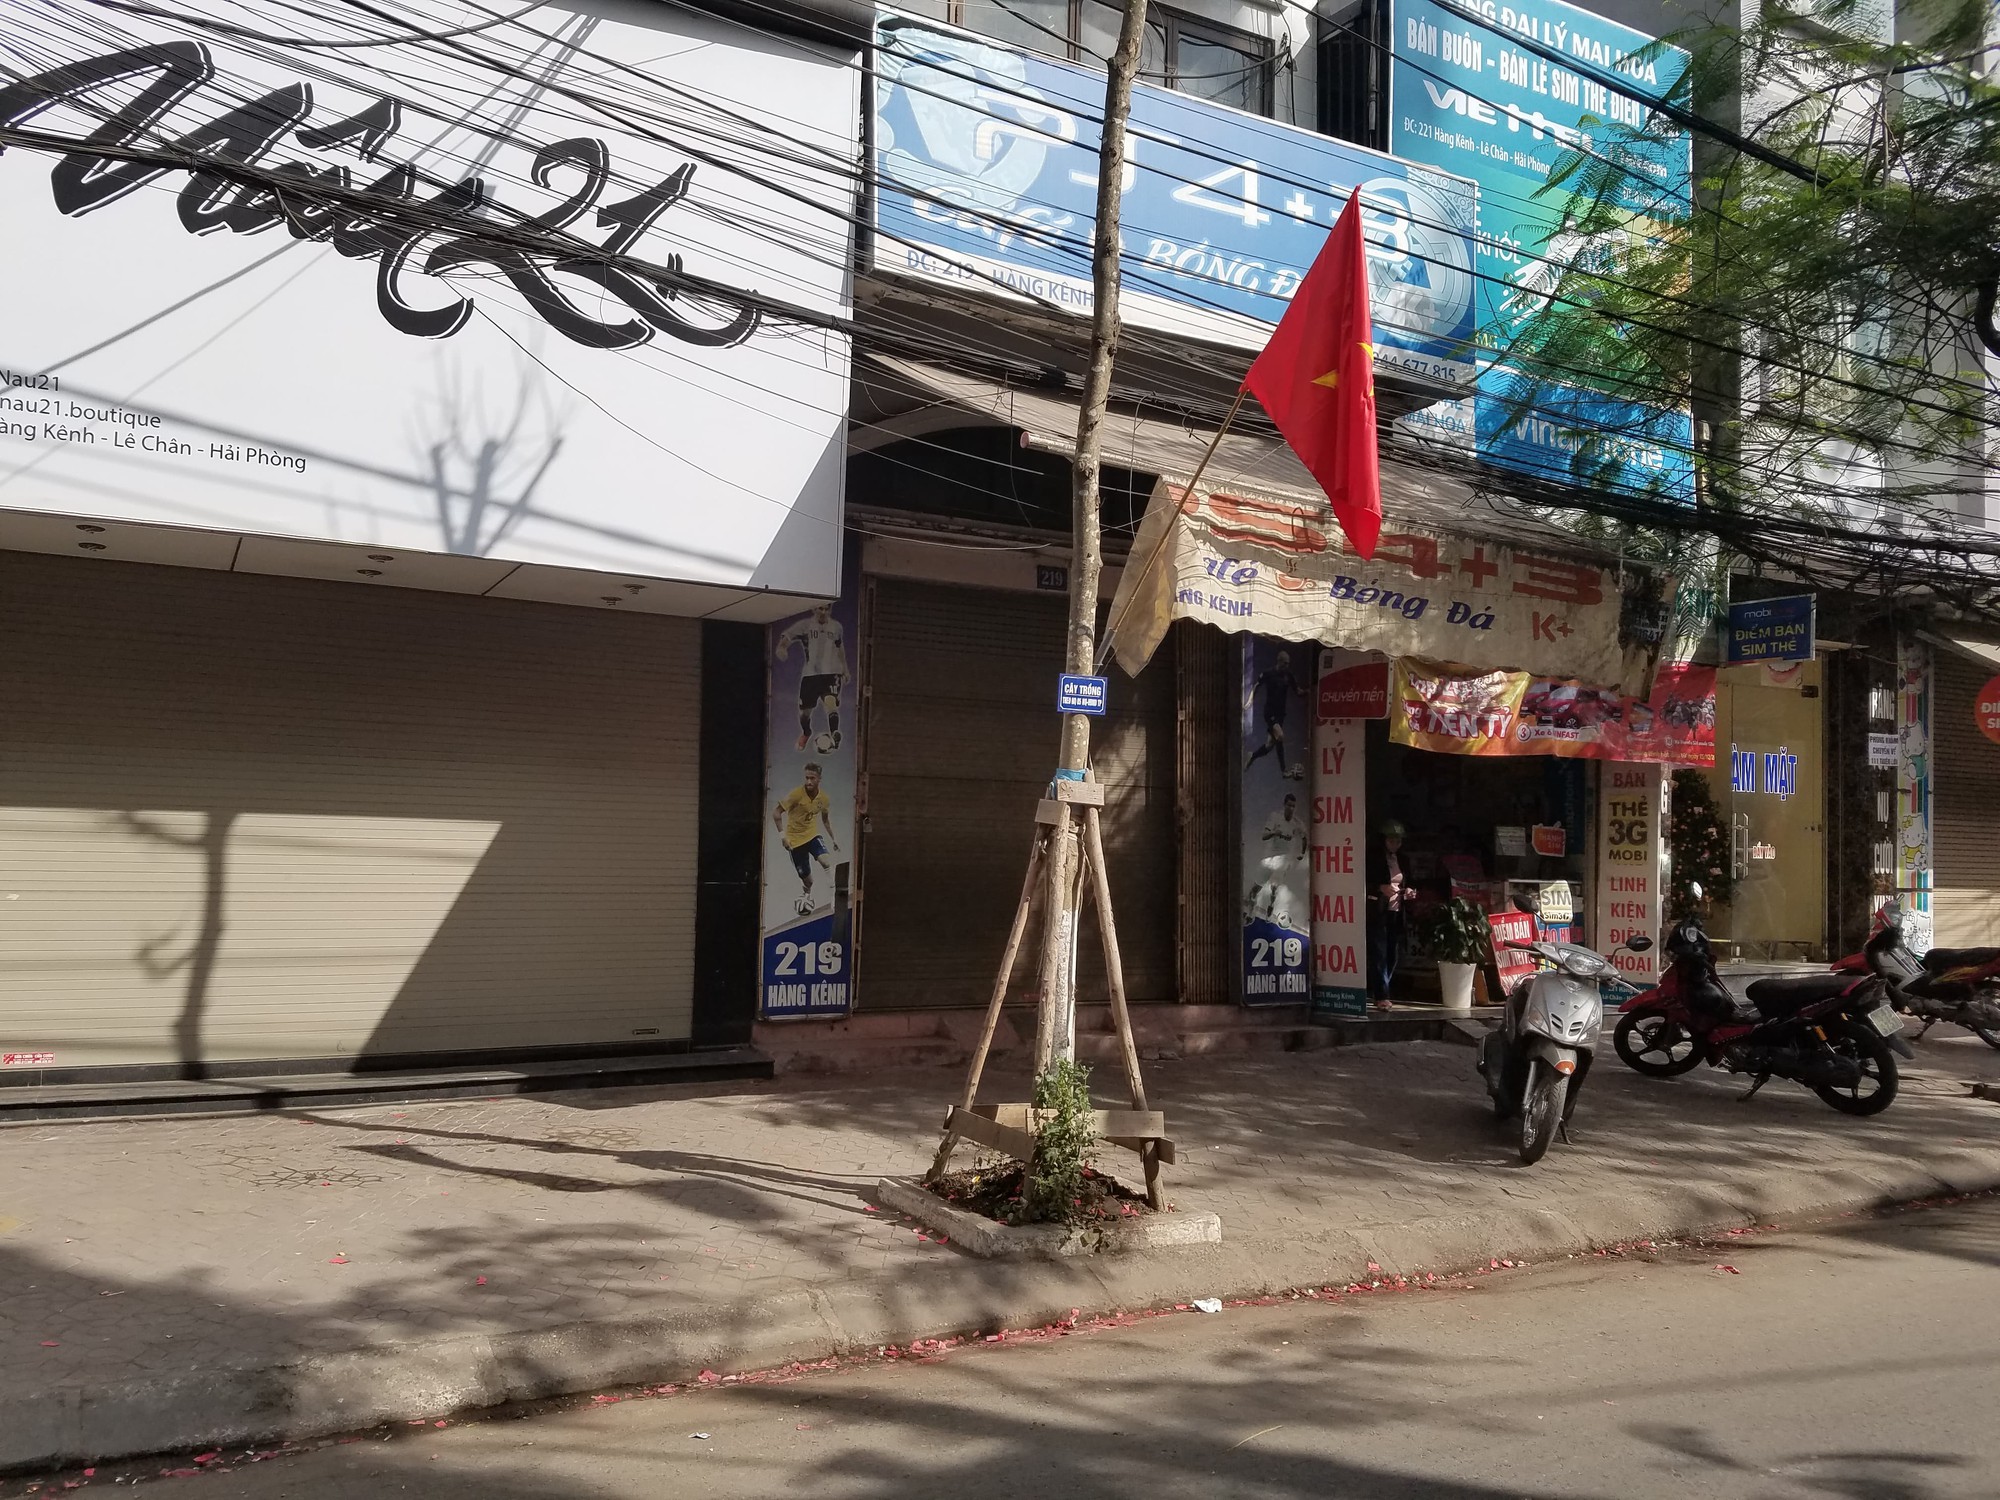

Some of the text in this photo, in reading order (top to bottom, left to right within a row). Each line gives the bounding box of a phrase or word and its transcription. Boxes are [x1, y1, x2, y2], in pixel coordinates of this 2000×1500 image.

[1407, 16, 1437, 57] BÁN
[1442, 29, 1482, 73] BUÔN
[1500, 46, 1528, 88] BÁN
[1532, 58, 1547, 95] LẺ
[1552, 67, 1579, 107] SIM
[1501, 12, 1539, 41] ĐẠI
[1543, 20, 1568, 51] LÝ
[1572, 34, 1609, 66] MAI
[1613, 50, 1657, 86] HOA
[1404, 117, 1417, 135] ĐC:
[1418, 121, 1433, 140] 221
[1434, 125, 1454, 149] Hàng
[1455, 130, 1475, 151] Kênh
[1480, 140, 1490, 156] Lê
[1490, 144, 1510, 162] Chân
[1514, 150, 1527, 168] Hải
[1527, 155, 1550, 178] Phòng
[1476, 229, 1522, 266] KHỎE
[906, 248, 938, 275] ĐC:
[991, 265, 1045, 297] HÀNG
[1048, 279, 1095, 309] KÊNH
[1140, 236, 1267, 298] BÓNG
[1268, 266, 1304, 302] Đ
[0, 370, 61, 392] Nau21
[0, 397, 162, 429] nau21.boutique
[43, 422, 95, 444] Kênh
[114, 431, 136, 449] Lê
[141, 436, 192, 456] Chân
[210, 443, 240, 462] Hải
[246, 448, 307, 473] Phòng
[1041, 570, 1063, 586] 219
[1209, 594, 1253, 617] KÊNH
[1329, 574, 1426, 620] Bóng
[1447, 600, 1496, 630] Đá
[1532, 611, 1575, 643] K+
[1735, 622, 1804, 640] ĐIỂM BÁN
[1741, 643, 1767, 656] SIM
[1064, 683, 1078, 695] CÂY
[1870, 682, 1895, 720] RĂNG
[1484, 706, 1513, 738] TỶ
[1553, 731, 1580, 739] INFAST
[1321, 744, 1346, 775] LÝ
[1763, 746, 1798, 801] MẶT
[1612, 770, 1646, 788] BÁN
[1313, 797, 1353, 824] SIM
[1608, 796, 1649, 818] THẺ
[1608, 819, 1648, 846] 3G
[1315, 838, 1354, 874] THẺ
[1608, 849, 1648, 862] MOBI
[1541, 889, 1572, 906] SIM
[1610, 876, 1647, 892] LINH
[1314, 896, 1354, 923] MAI
[1610, 901, 1646, 922] KIỆN
[1493, 916, 1530, 943] ĐIỂM BÁN
[775, 941, 843, 976] 219
[1252, 938, 1302, 967] 219
[1315, 945, 1358, 974] HOA
[1605, 954, 1652, 976] THOẠI
[767, 979, 847, 1008] HÀNG KÊNH
[1247, 970, 1307, 994] HÀNG KÊNH
